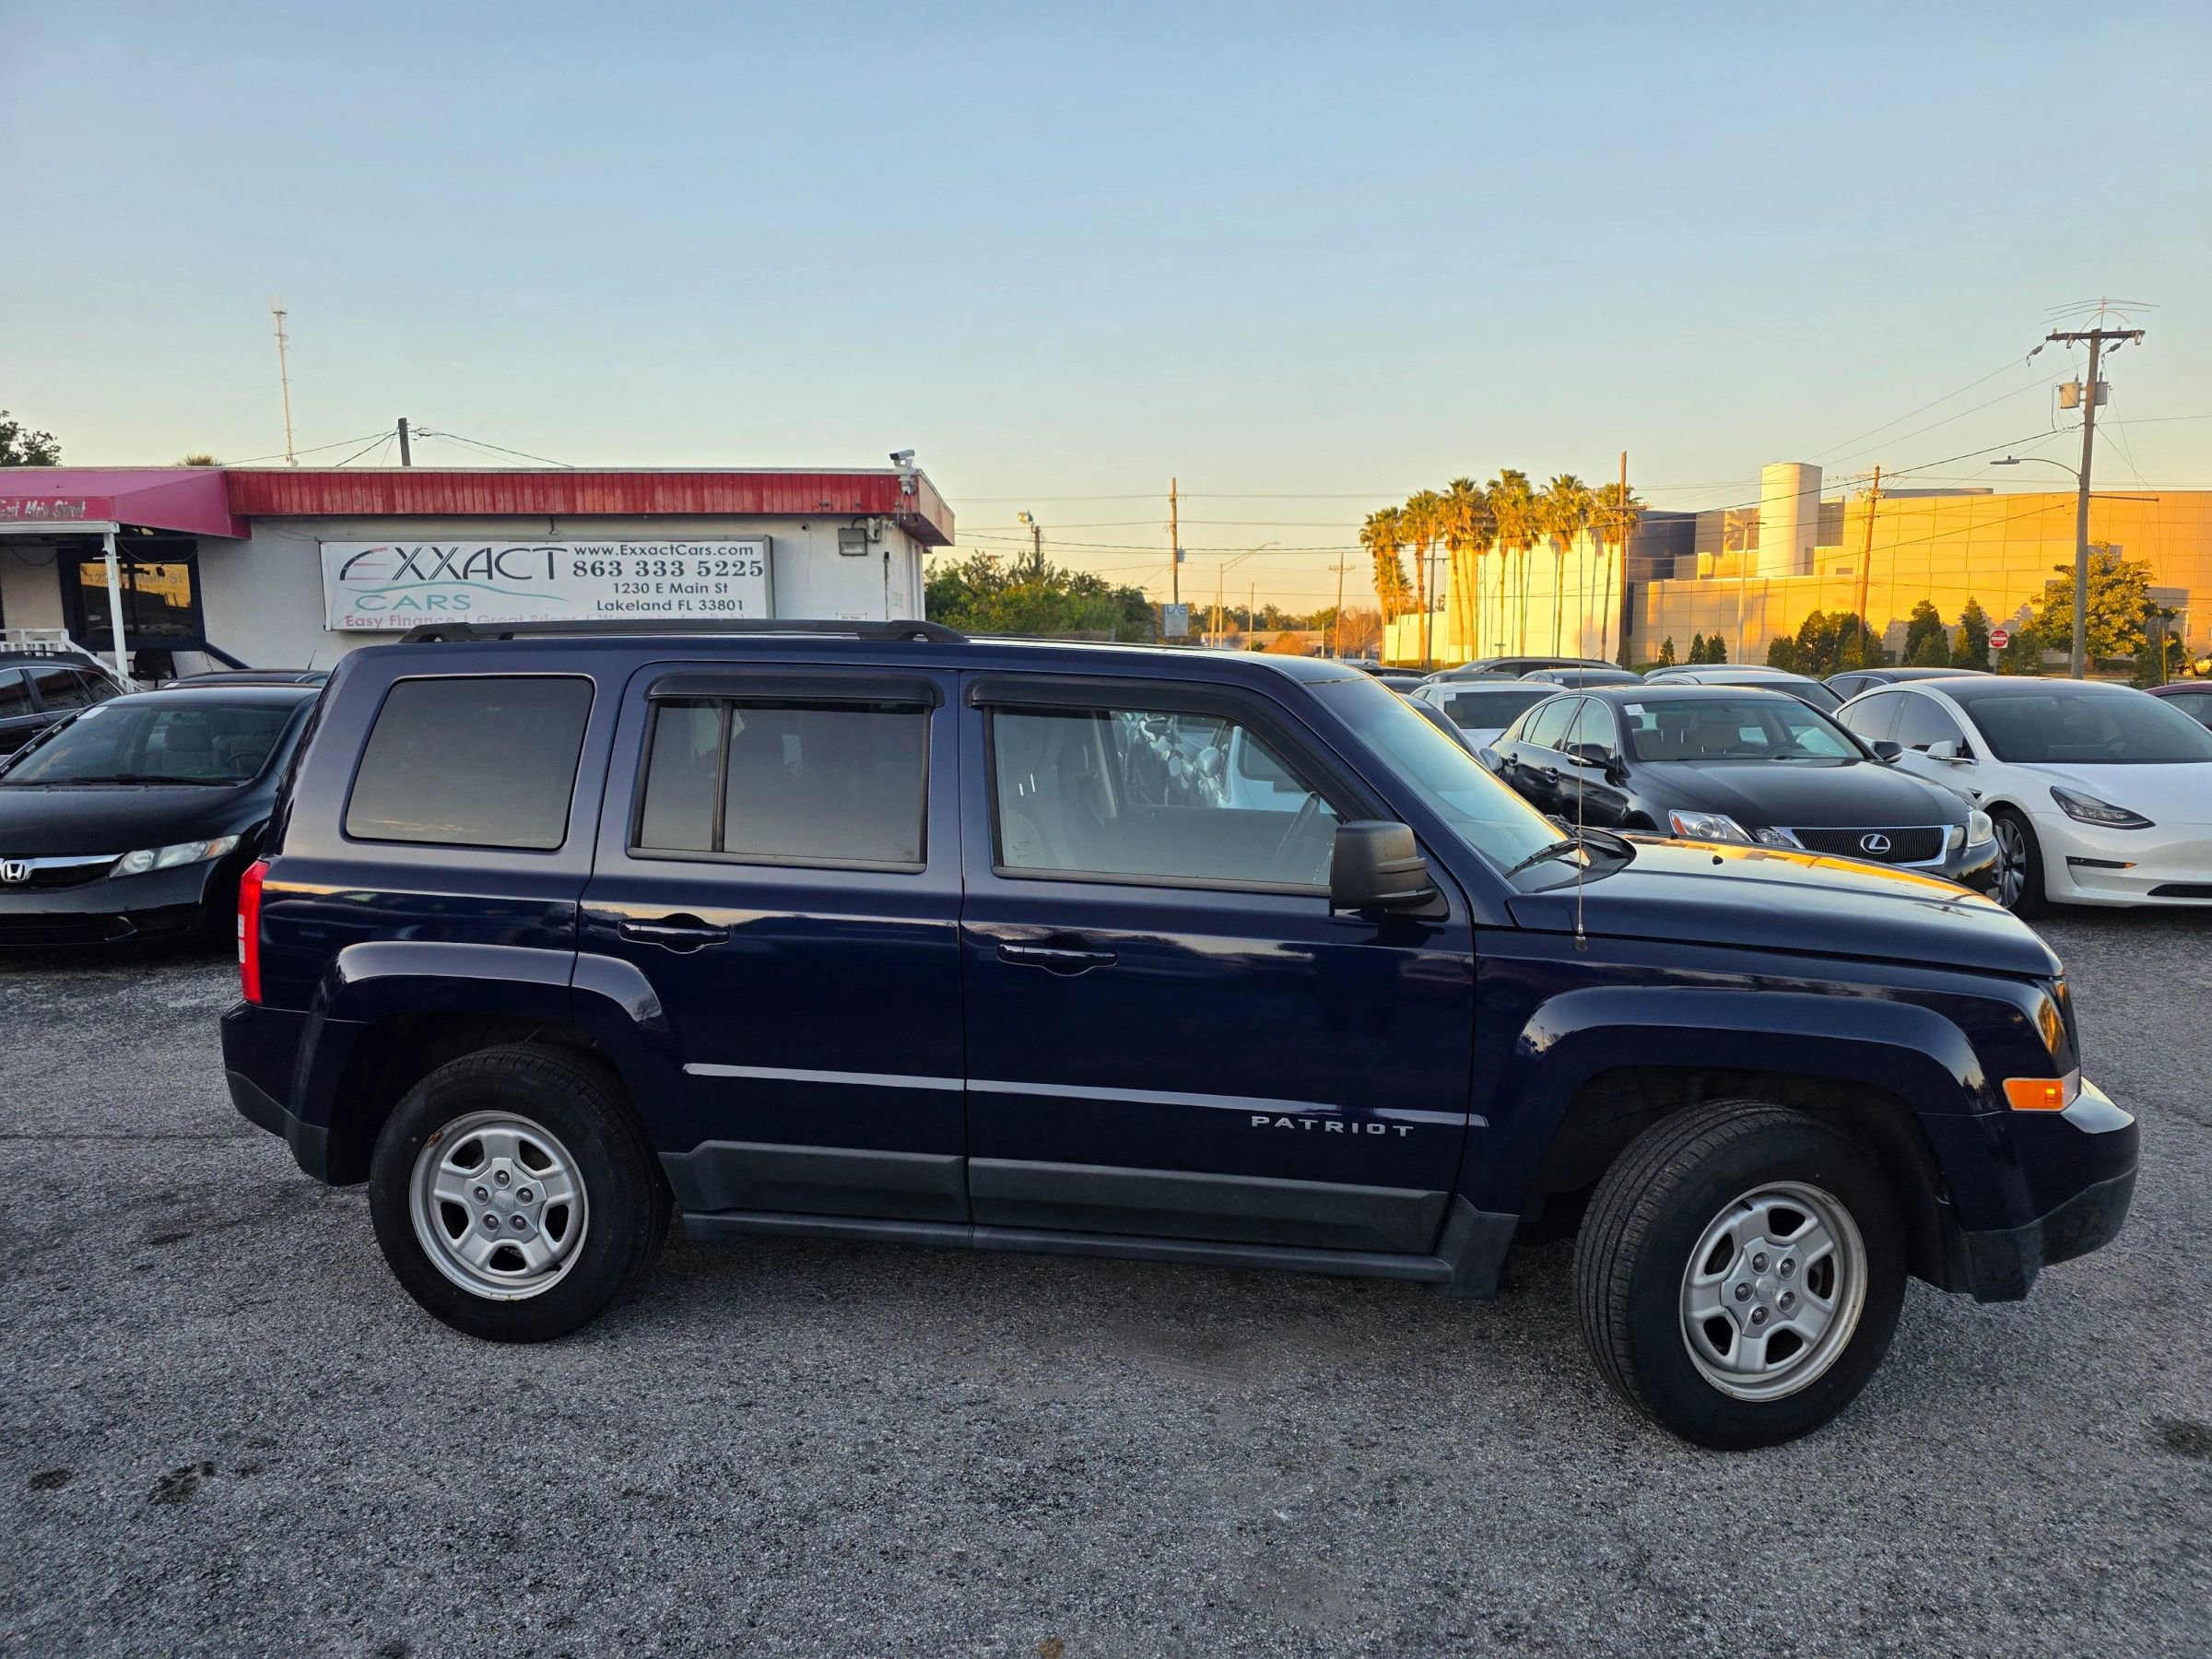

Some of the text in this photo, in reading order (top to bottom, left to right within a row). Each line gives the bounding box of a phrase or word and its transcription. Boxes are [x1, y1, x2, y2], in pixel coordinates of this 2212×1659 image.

[573, 543, 754, 556] www.ExxactCars.com
[339, 546, 568, 581] EXXACT
[572, 559, 764, 578] 863 333 5225
[613, 582, 728, 594] 1230 E Main St
[354, 594, 472, 611] CARS
[596, 599, 743, 611] Lakeland FL 33801
[346, 615, 382, 629] Easy
[1251, 1115, 1414, 1137] PATRIOT
